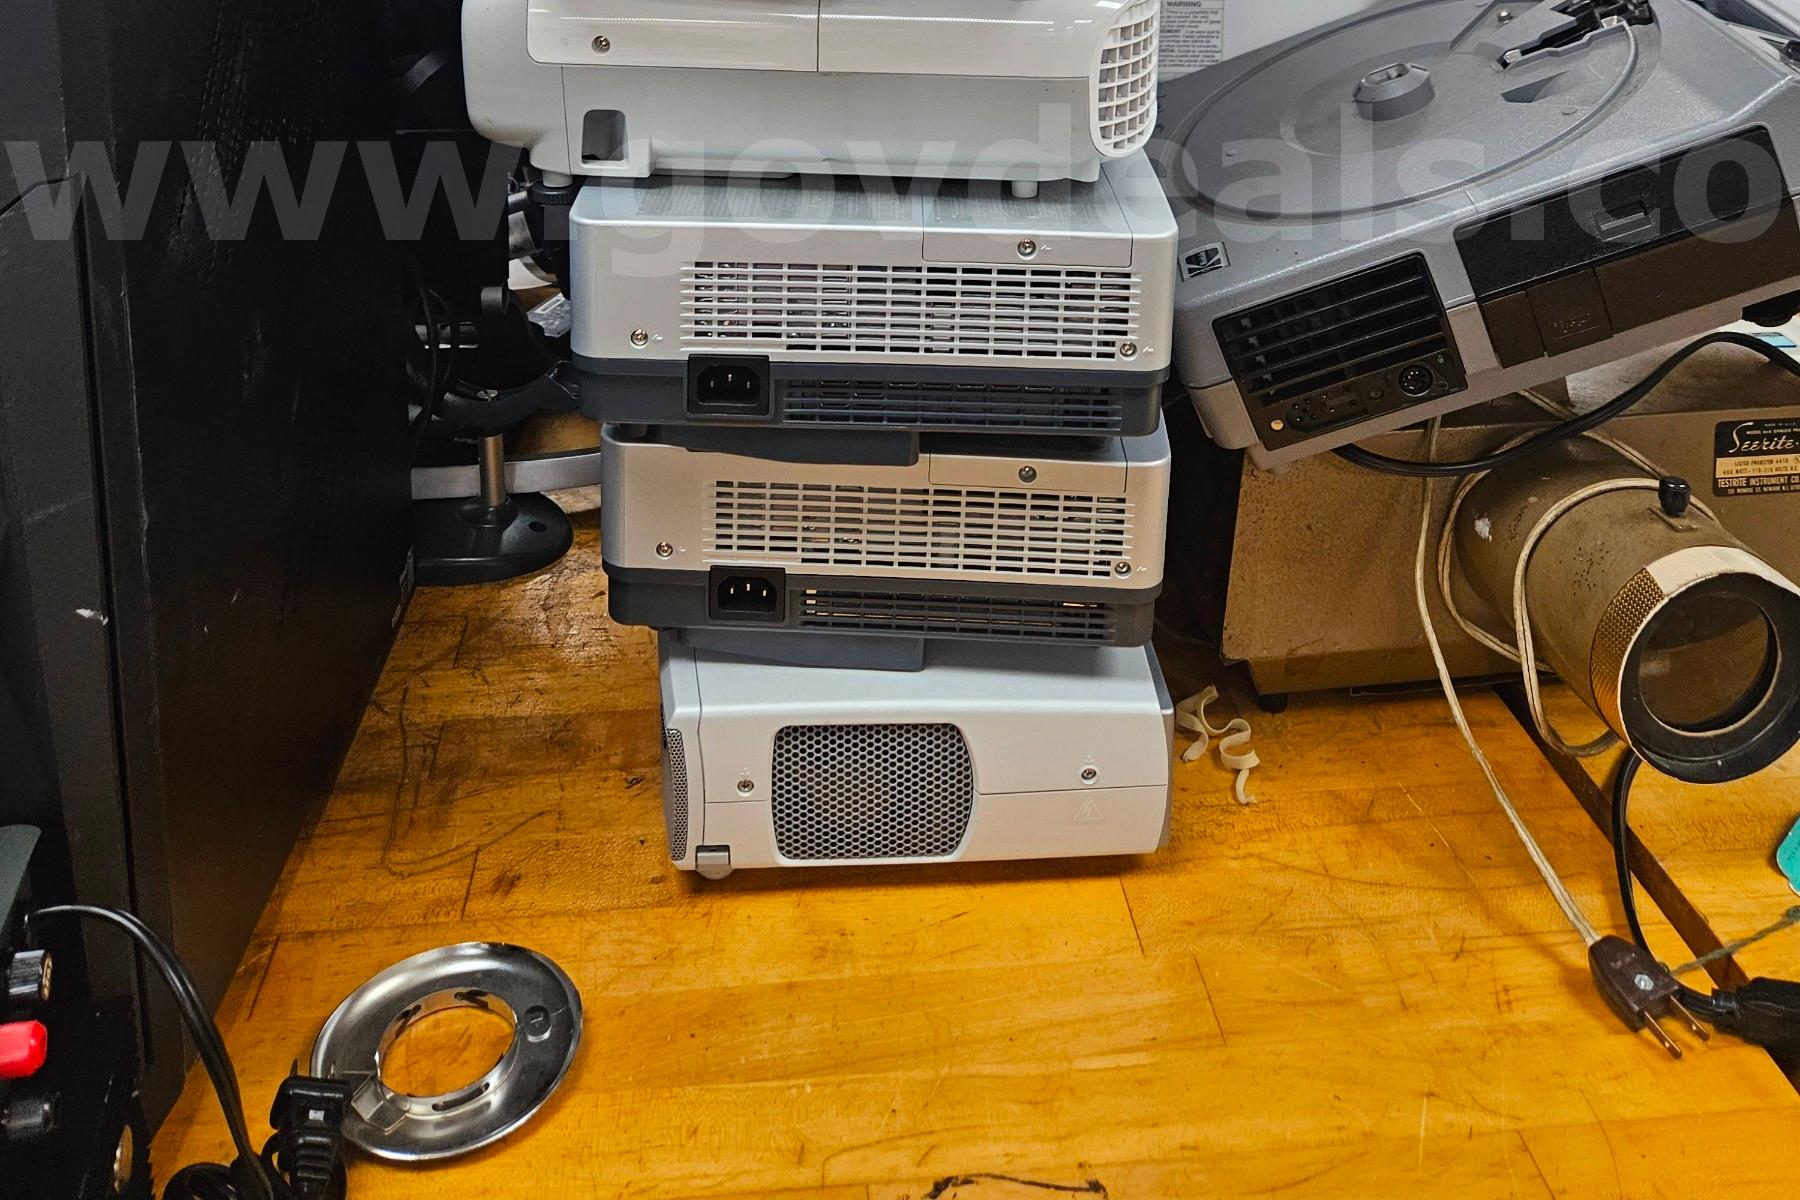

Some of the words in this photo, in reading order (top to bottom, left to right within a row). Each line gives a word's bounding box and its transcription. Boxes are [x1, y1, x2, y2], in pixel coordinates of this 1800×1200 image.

[1728, 421, 1795, 453] Seerite
[1718, 477, 1748, 488] TESTRITE
[1749, 476, 1788, 486] INSTRUMENT
